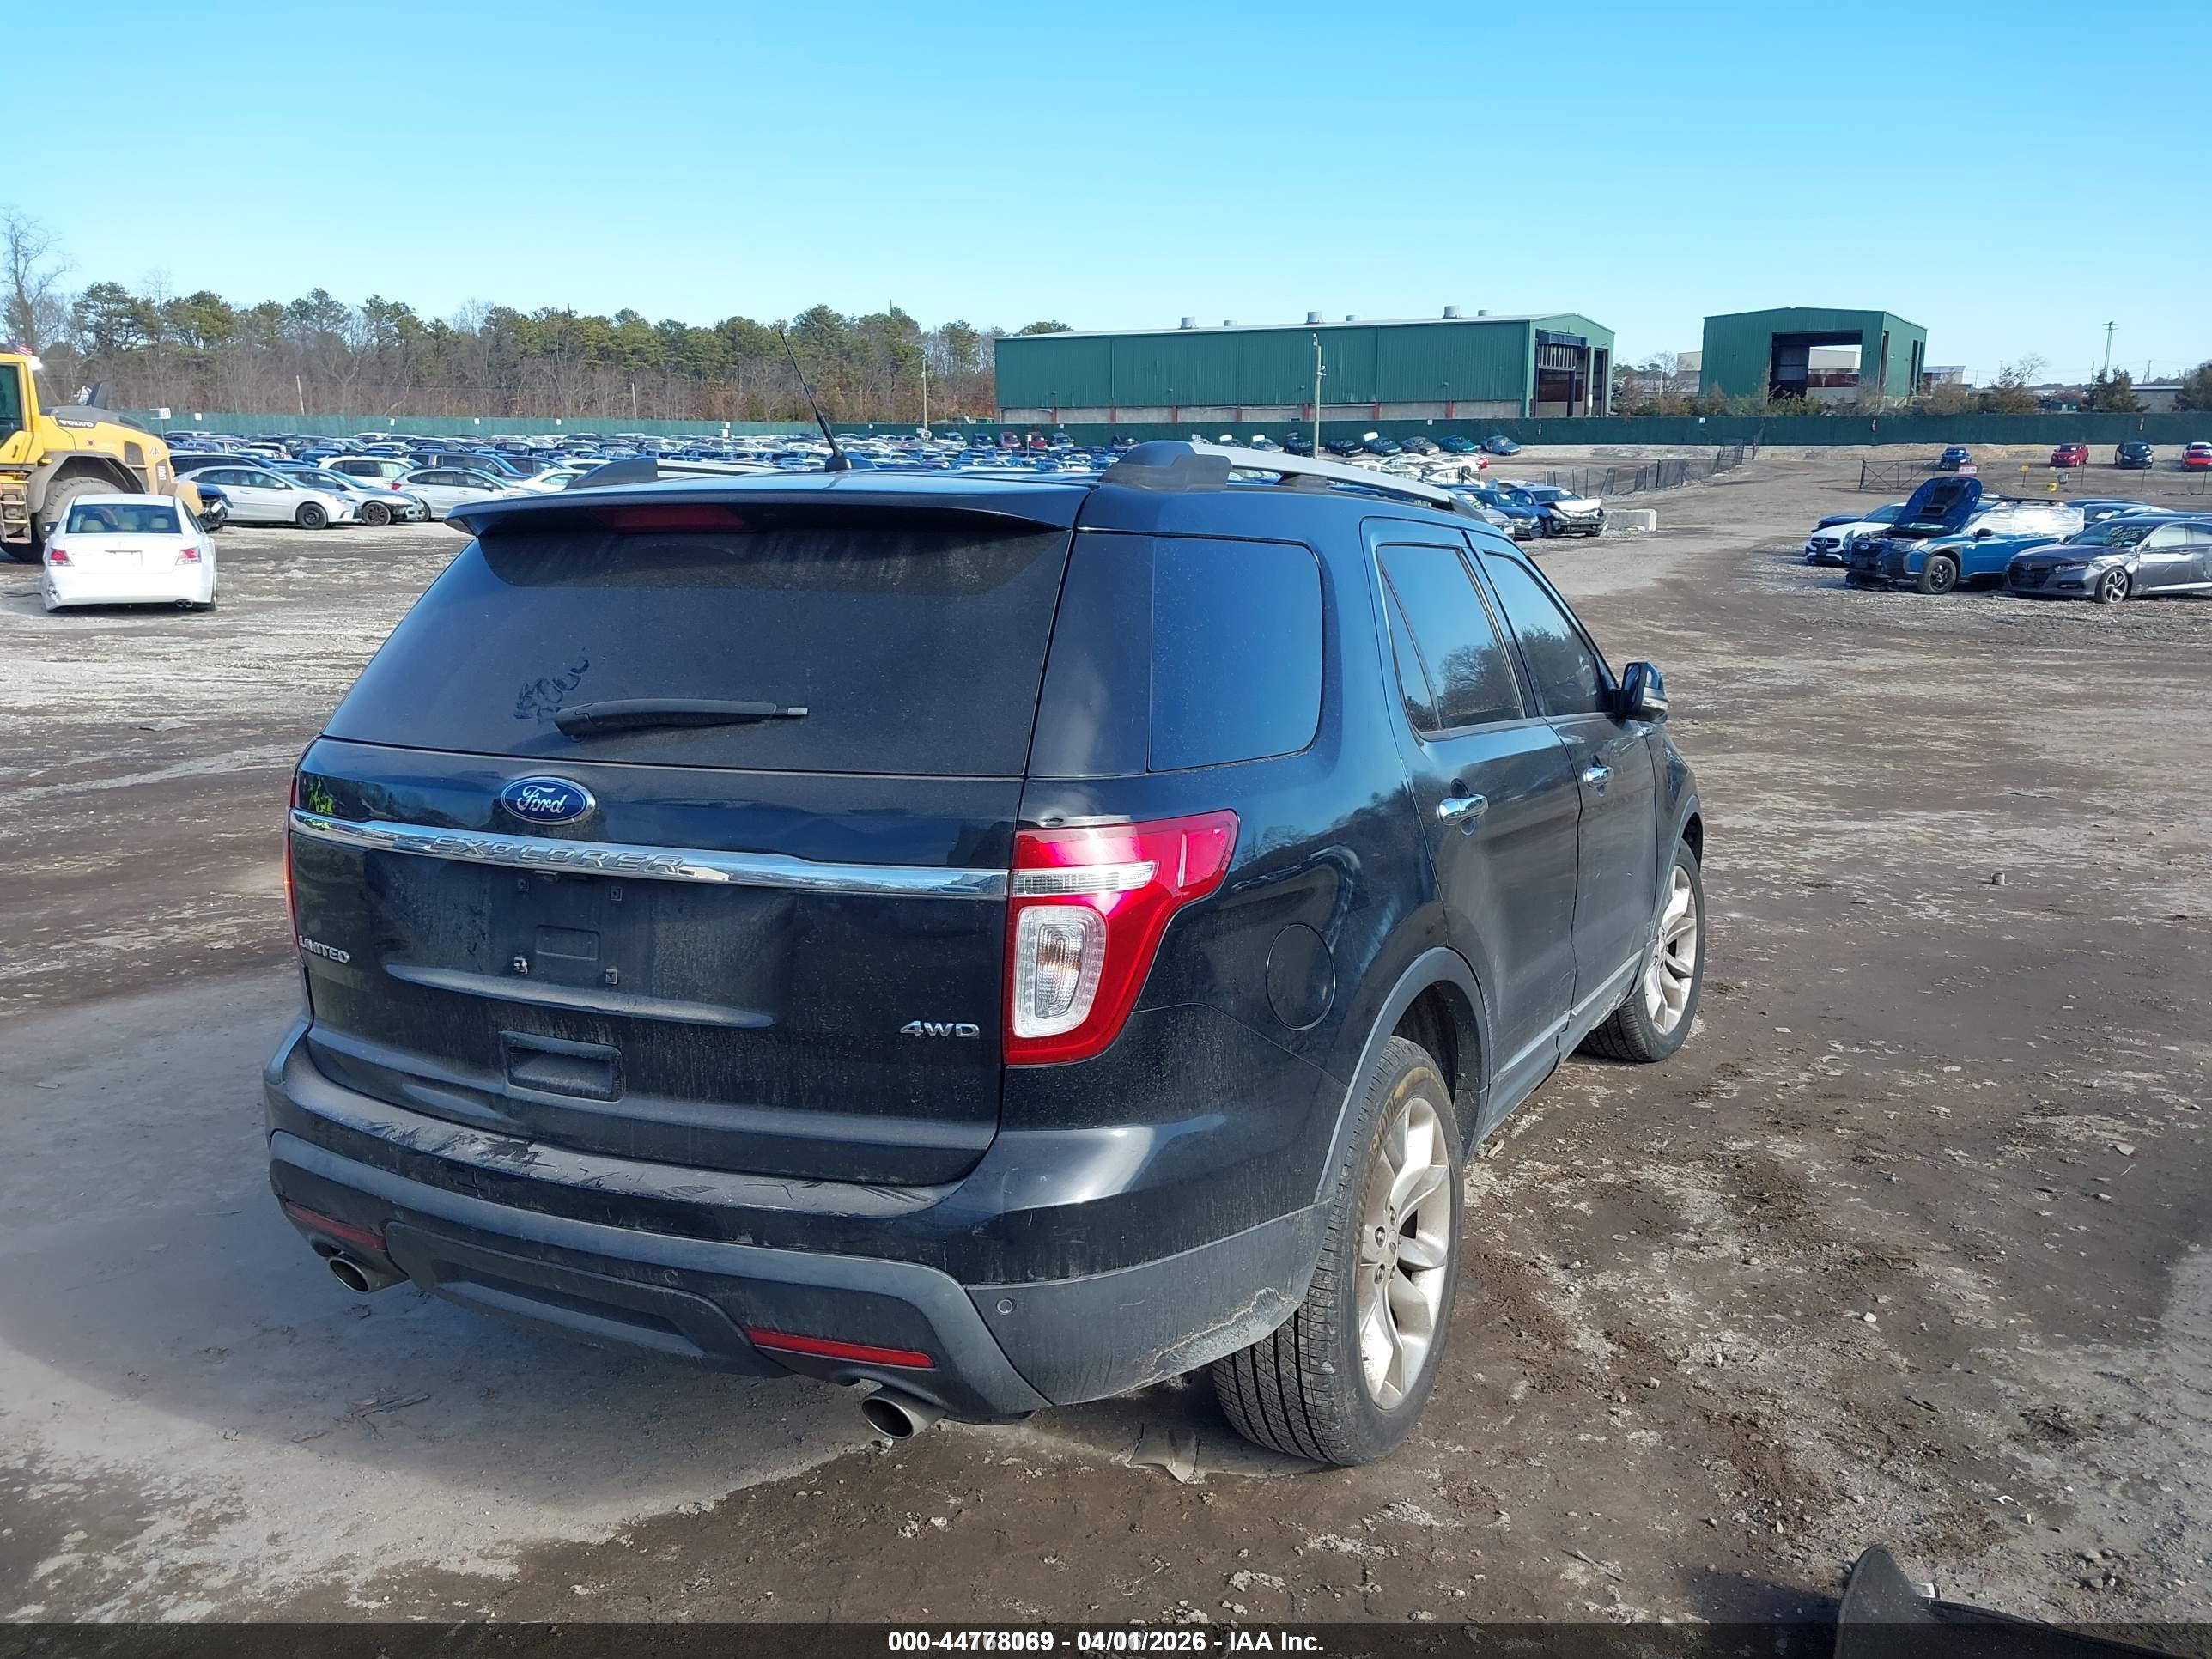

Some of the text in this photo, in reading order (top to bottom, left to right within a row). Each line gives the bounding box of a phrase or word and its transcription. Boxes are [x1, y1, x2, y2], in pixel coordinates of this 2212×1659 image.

[58, 419, 94, 428] VOLVO
[516, 785, 566, 814] Ford
[433, 835, 685, 874] EXPLORER
[298, 934, 351, 963] LIMITED
[899, 1020, 980, 1037] 4WD
